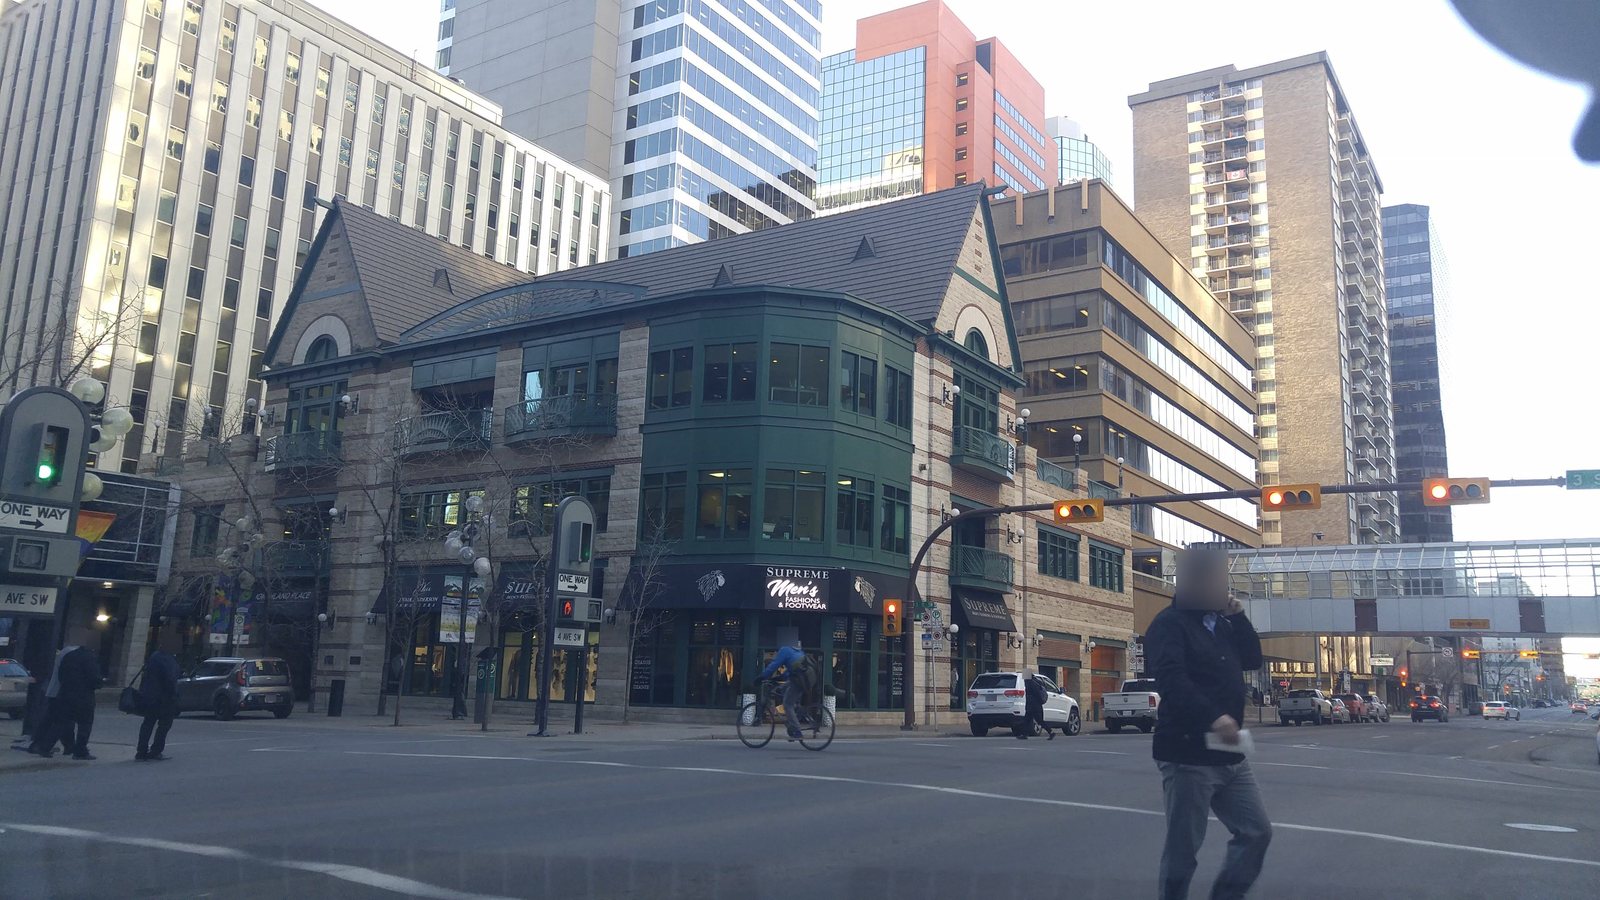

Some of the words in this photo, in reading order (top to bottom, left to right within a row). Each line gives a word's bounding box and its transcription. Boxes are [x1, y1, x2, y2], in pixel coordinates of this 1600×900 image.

[1573, 474, 1582, 486] 3
[1, 502, 33, 517] ONE
[38, 506, 68, 520] WAY
[766, 566, 830, 579] SUPREME
[560, 574, 573, 583] ONE
[575, 575, 588, 584] WAY
[767, 579, 819, 598] Men's
[5, 592, 26, 604] AVE
[31, 593, 49, 606] SW
[785, 596, 820, 604] FASHIONS
[785, 602, 827, 610] FOOTWEAR
[963, 597, 1007, 615] SUPREME
[563, 632, 571, 640] AVE
[573, 633, 582, 641] SW
